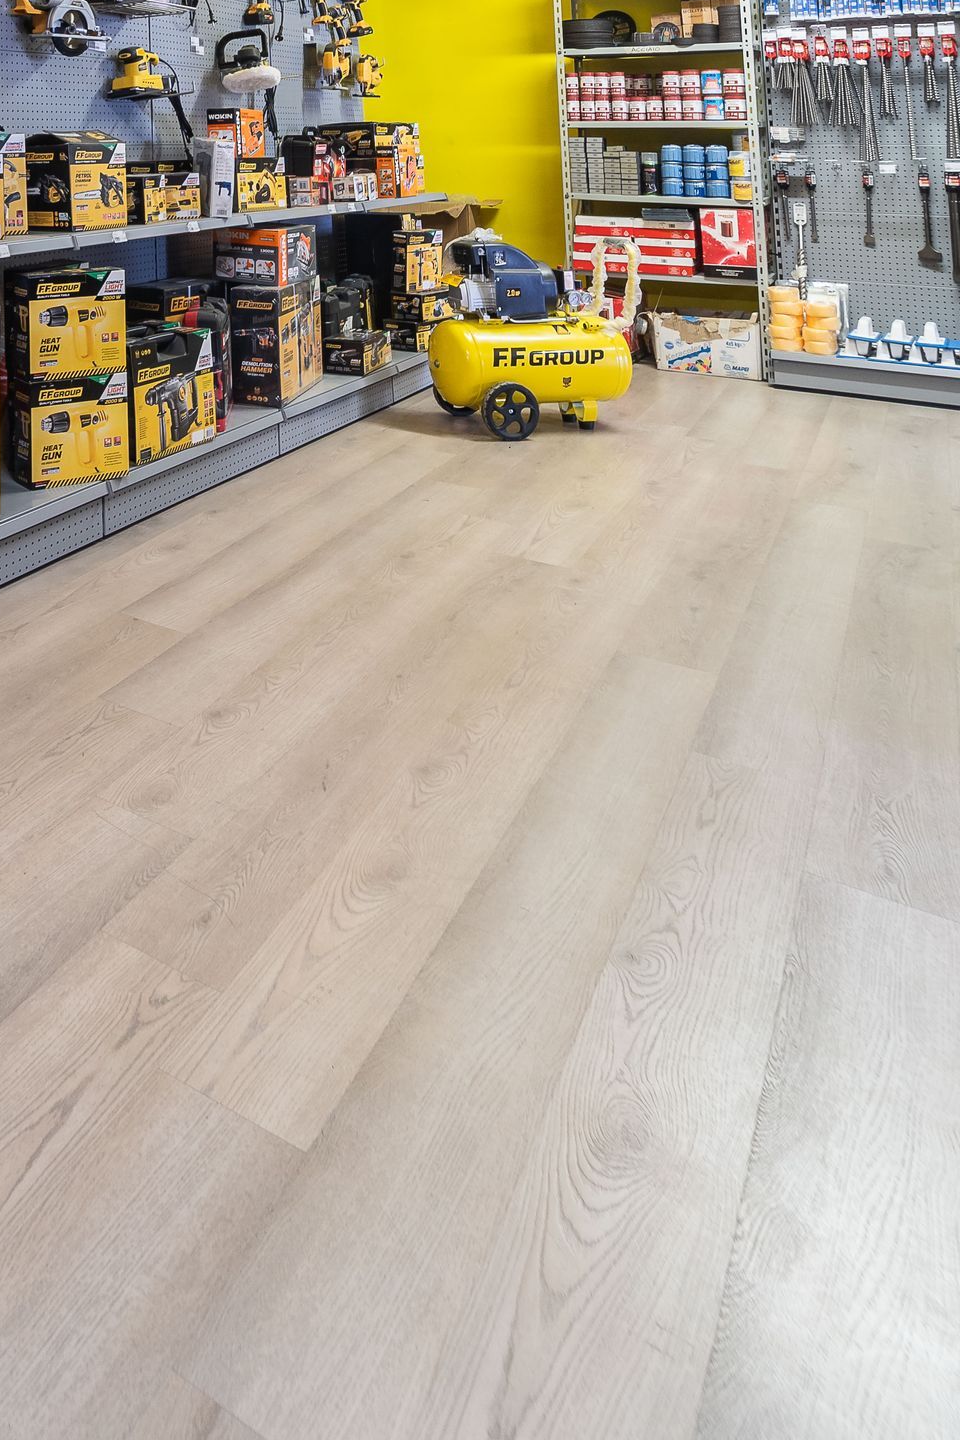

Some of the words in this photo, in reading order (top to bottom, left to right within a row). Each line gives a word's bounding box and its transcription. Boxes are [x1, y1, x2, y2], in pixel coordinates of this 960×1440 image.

[40, 337, 61, 345] HEAT
[39, 344, 60, 353] GUN
[241, 360, 273, 368] DEMOLITION
[240, 365, 273, 374] HAMMER
[107, 386, 125, 394] LIGHT
[42, 443, 64, 453] HEAT
[41, 451, 63, 461] GUN
